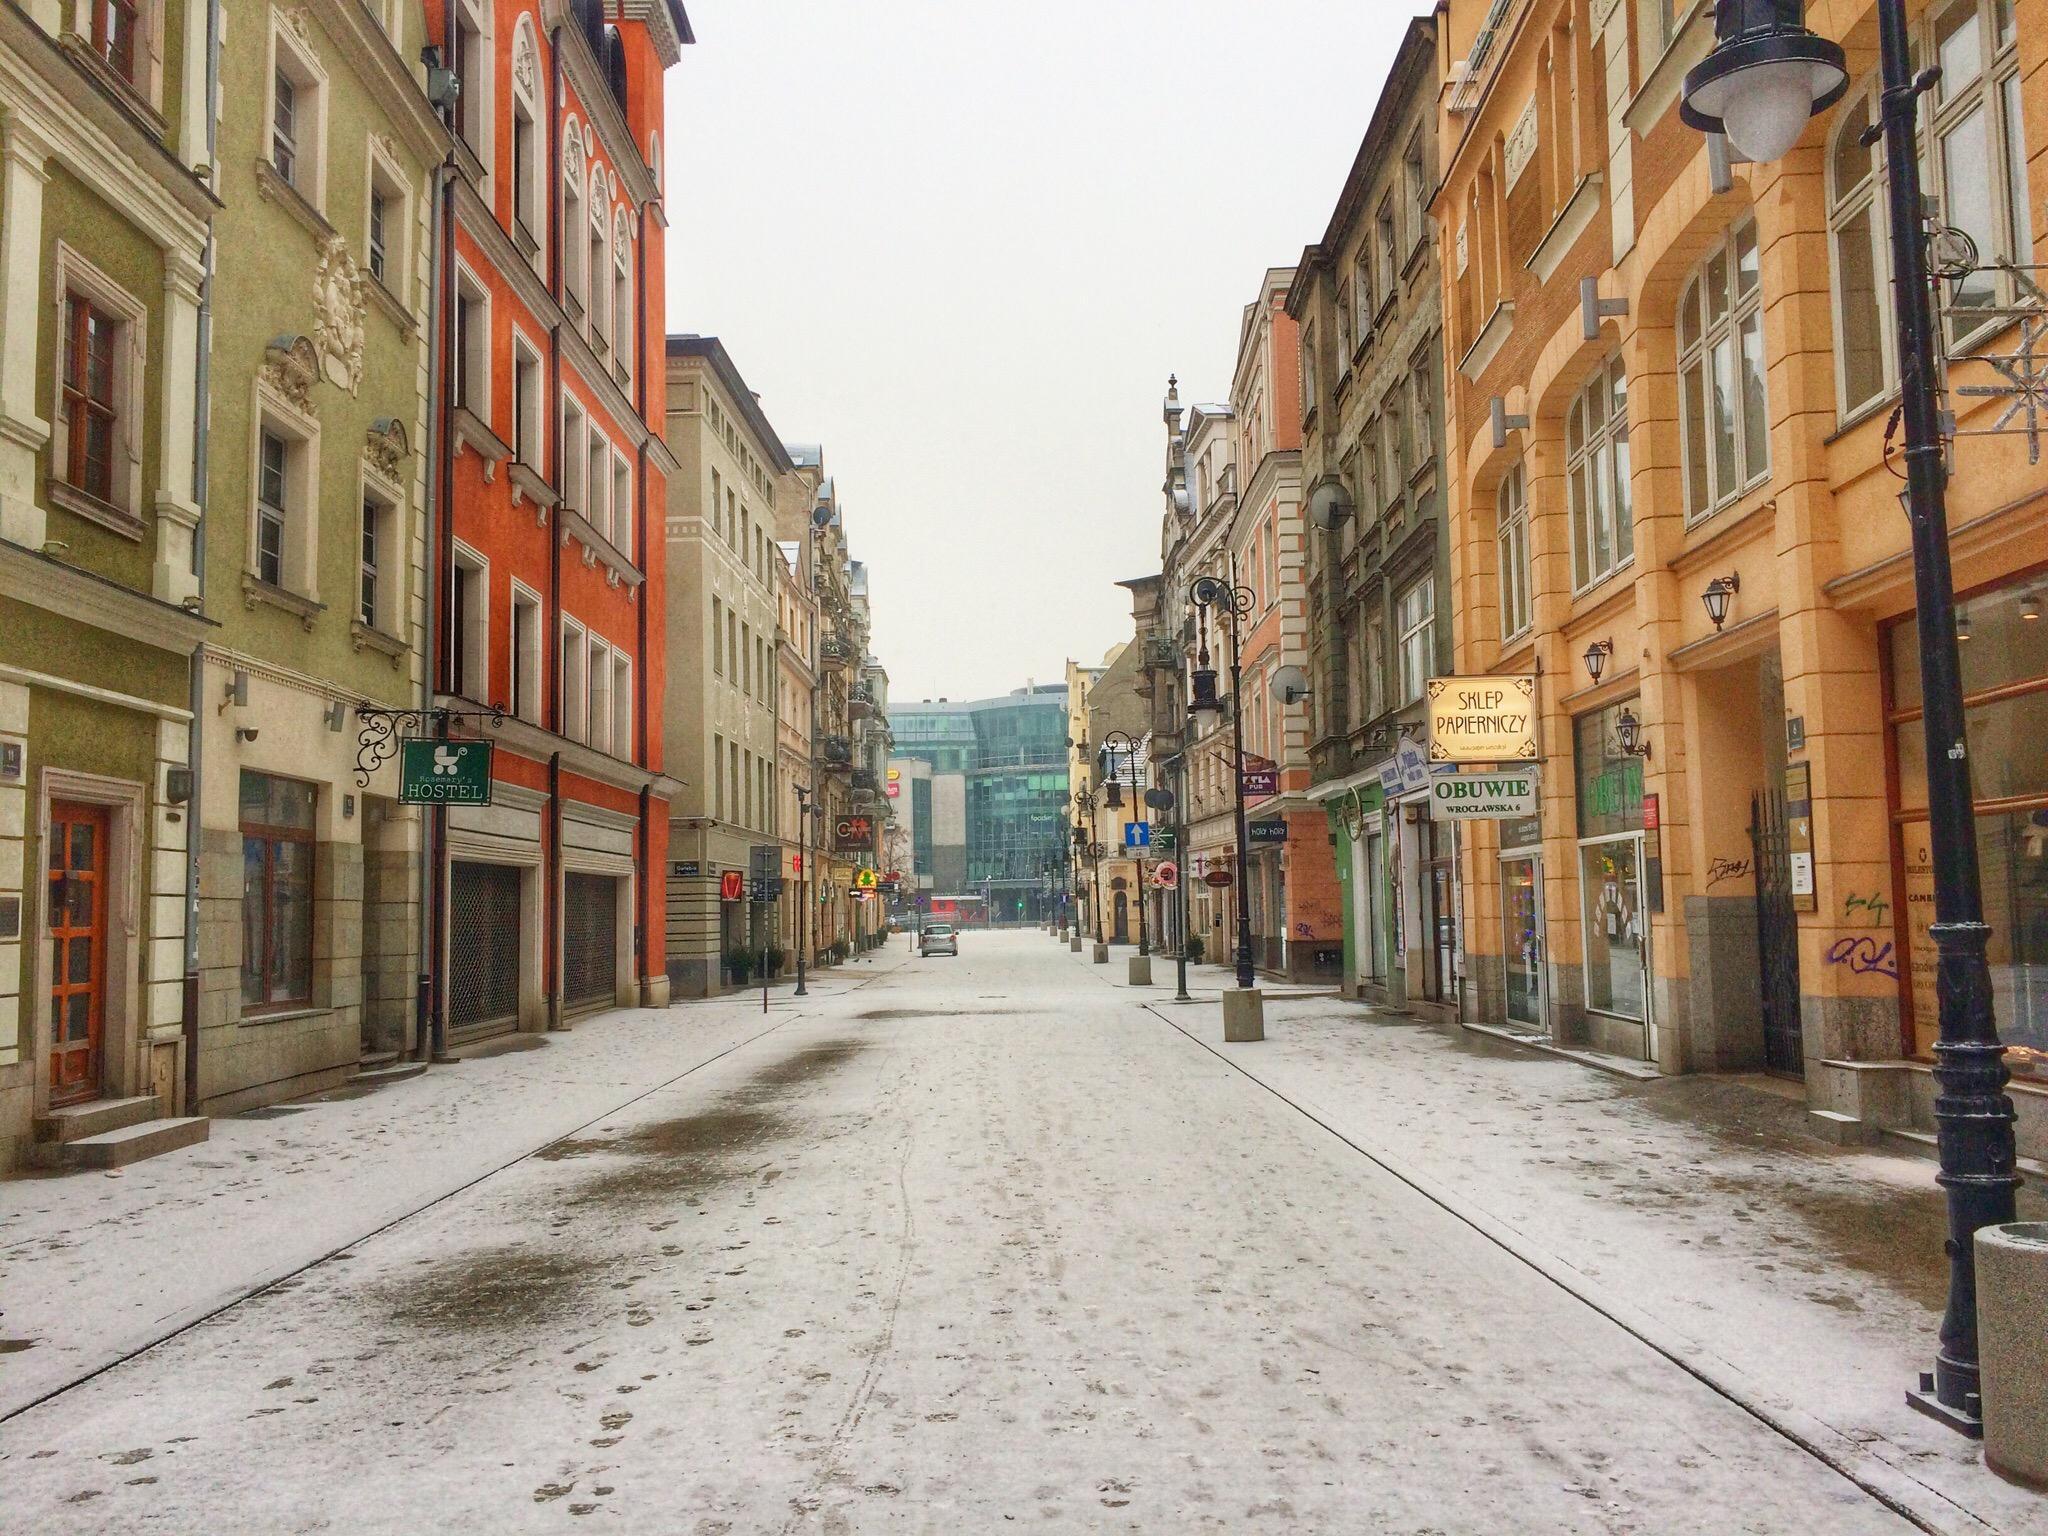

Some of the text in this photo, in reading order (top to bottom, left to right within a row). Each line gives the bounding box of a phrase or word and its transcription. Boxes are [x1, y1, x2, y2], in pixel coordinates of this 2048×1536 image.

[1458, 691, 1503, 710] SKLEP
[1437, 714, 1527, 734] PAPIERNICZY
[1623, 729, 1630, 738] 6
[420, 775, 473, 785] Rosemary's
[408, 783, 483, 799] HOSTEL
[1435, 779, 1530, 799] OBUWIE
[1446, 803, 1521, 814] WROCŁAWSKA 6
